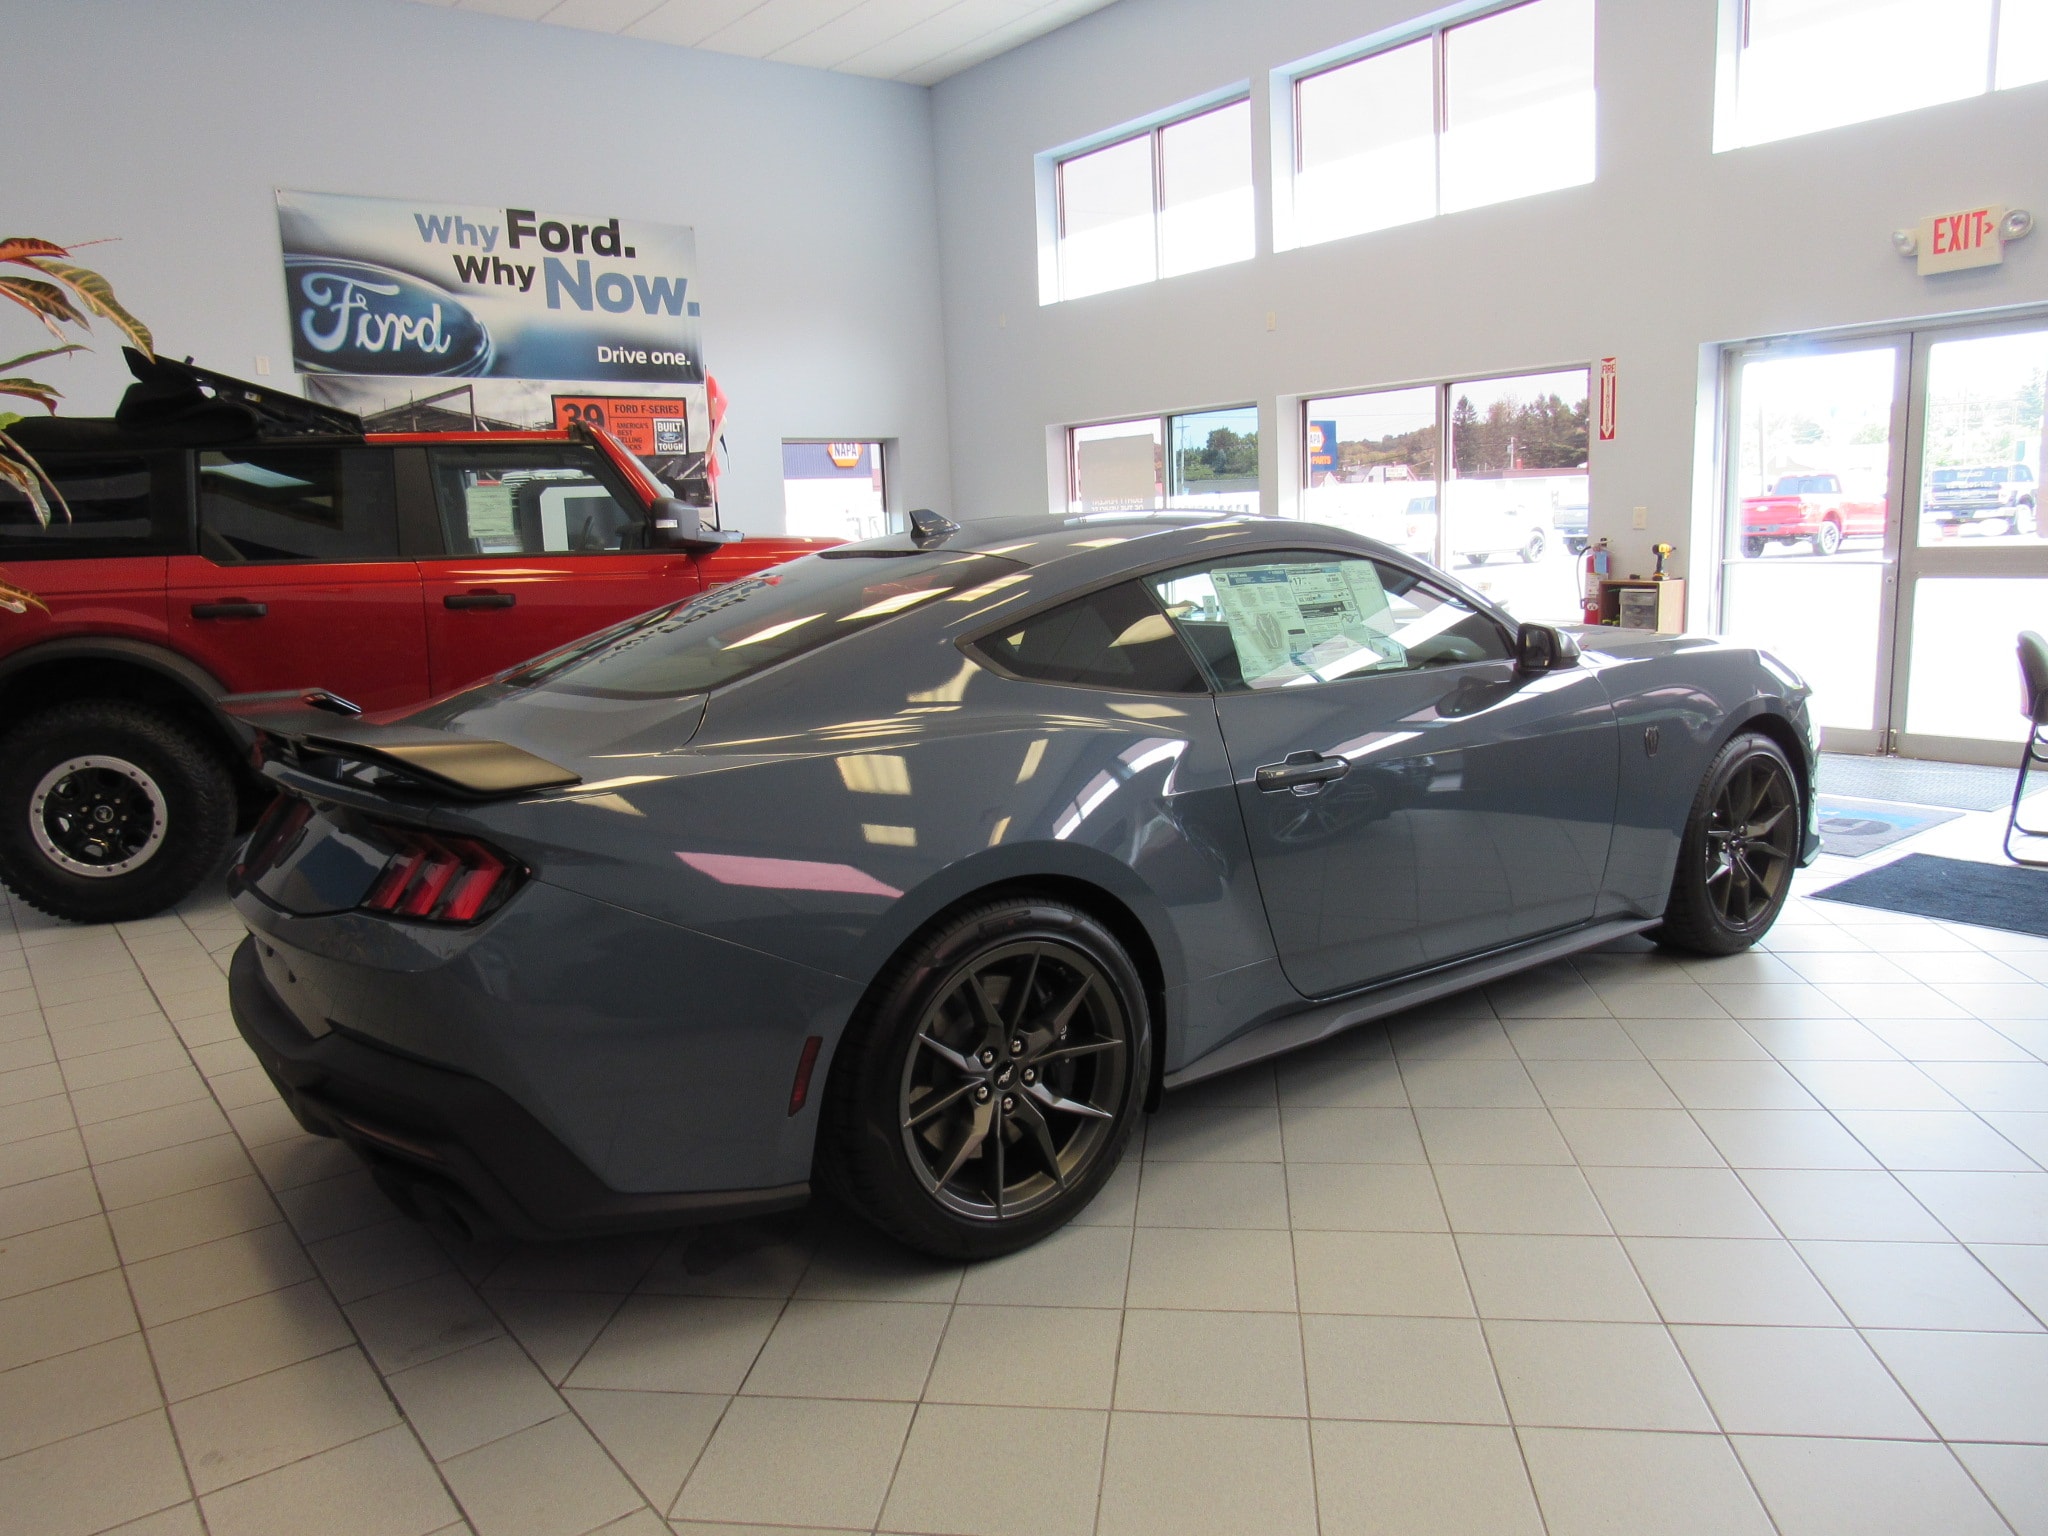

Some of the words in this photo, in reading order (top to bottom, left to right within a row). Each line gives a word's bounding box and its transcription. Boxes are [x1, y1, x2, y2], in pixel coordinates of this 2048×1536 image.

[413, 213, 500, 253] Why
[506, 208, 637, 258] Ford.
[1933, 210, 1988, 254] EXIT
[452, 254, 536, 293] Why
[543, 256, 701, 318] Now.
[301, 272, 451, 354] Ford
[597, 345, 648, 365] Drive
[650, 350, 691, 366] one.
[1602, 364, 1616, 374] FIRE
[614, 404, 639, 414] FORD
[640, 405, 679, 415] F-SERIES
[657, 422, 682, 432] BUILT
[658, 443, 684, 451] TOUGH
[834, 443, 858, 457] NAPA
